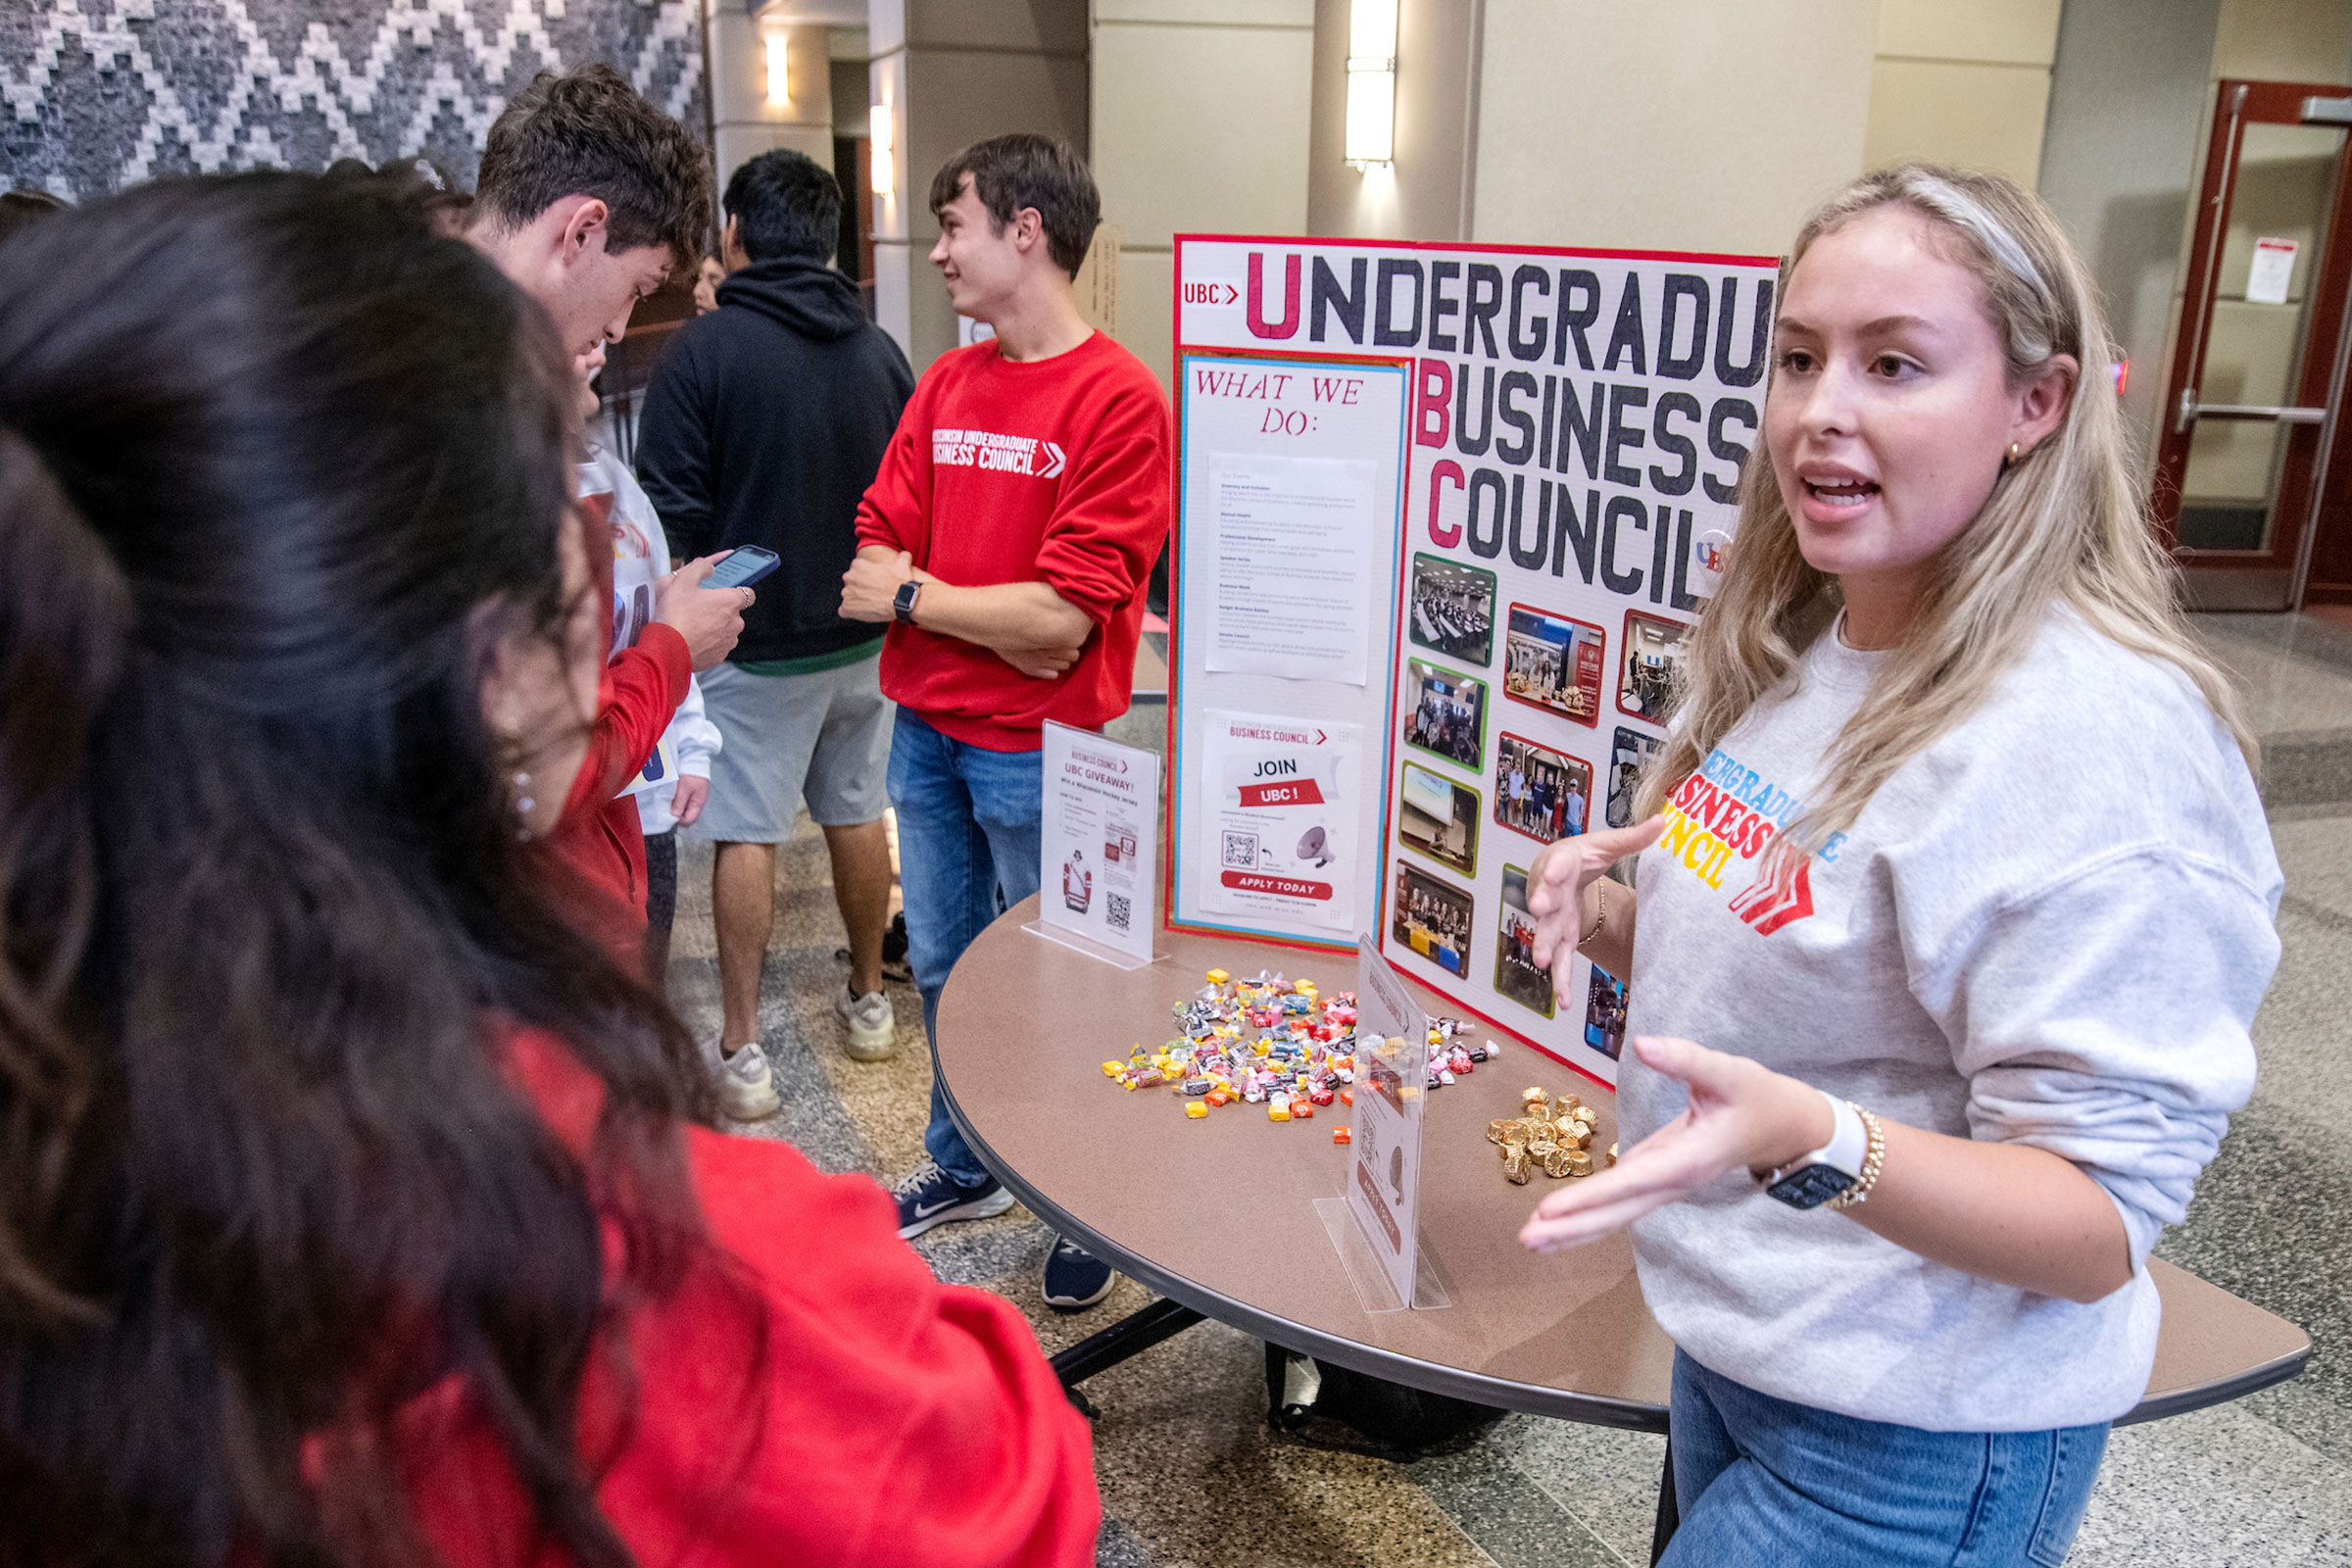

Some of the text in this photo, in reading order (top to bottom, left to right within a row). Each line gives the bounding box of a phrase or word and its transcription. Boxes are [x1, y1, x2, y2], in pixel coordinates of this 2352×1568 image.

[1184, 282, 1220, 305] UBC
[1246, 252, 1774, 388] UNDERGRADU
[1195, 368, 1366, 407] WHAT WE
[1260, 407, 1319, 436] DO:
[1415, 358, 1760, 505] BUSINESS
[963, 429, 1039, 454] UNDERGRADUATE
[978, 447, 1034, 476] COUNCIL
[1427, 459, 1703, 611] COUNCIL
[1230, 726, 1309, 745] BUSINESS COUNCIL
[1071, 750, 1118, 772] BUSINESS COUNCIL
[1253, 759, 1298, 777] JOIN
[1064, 762, 1135, 793] UBC GIVEAWAY!
[1239, 877, 1315, 895] APPLY TODAY
